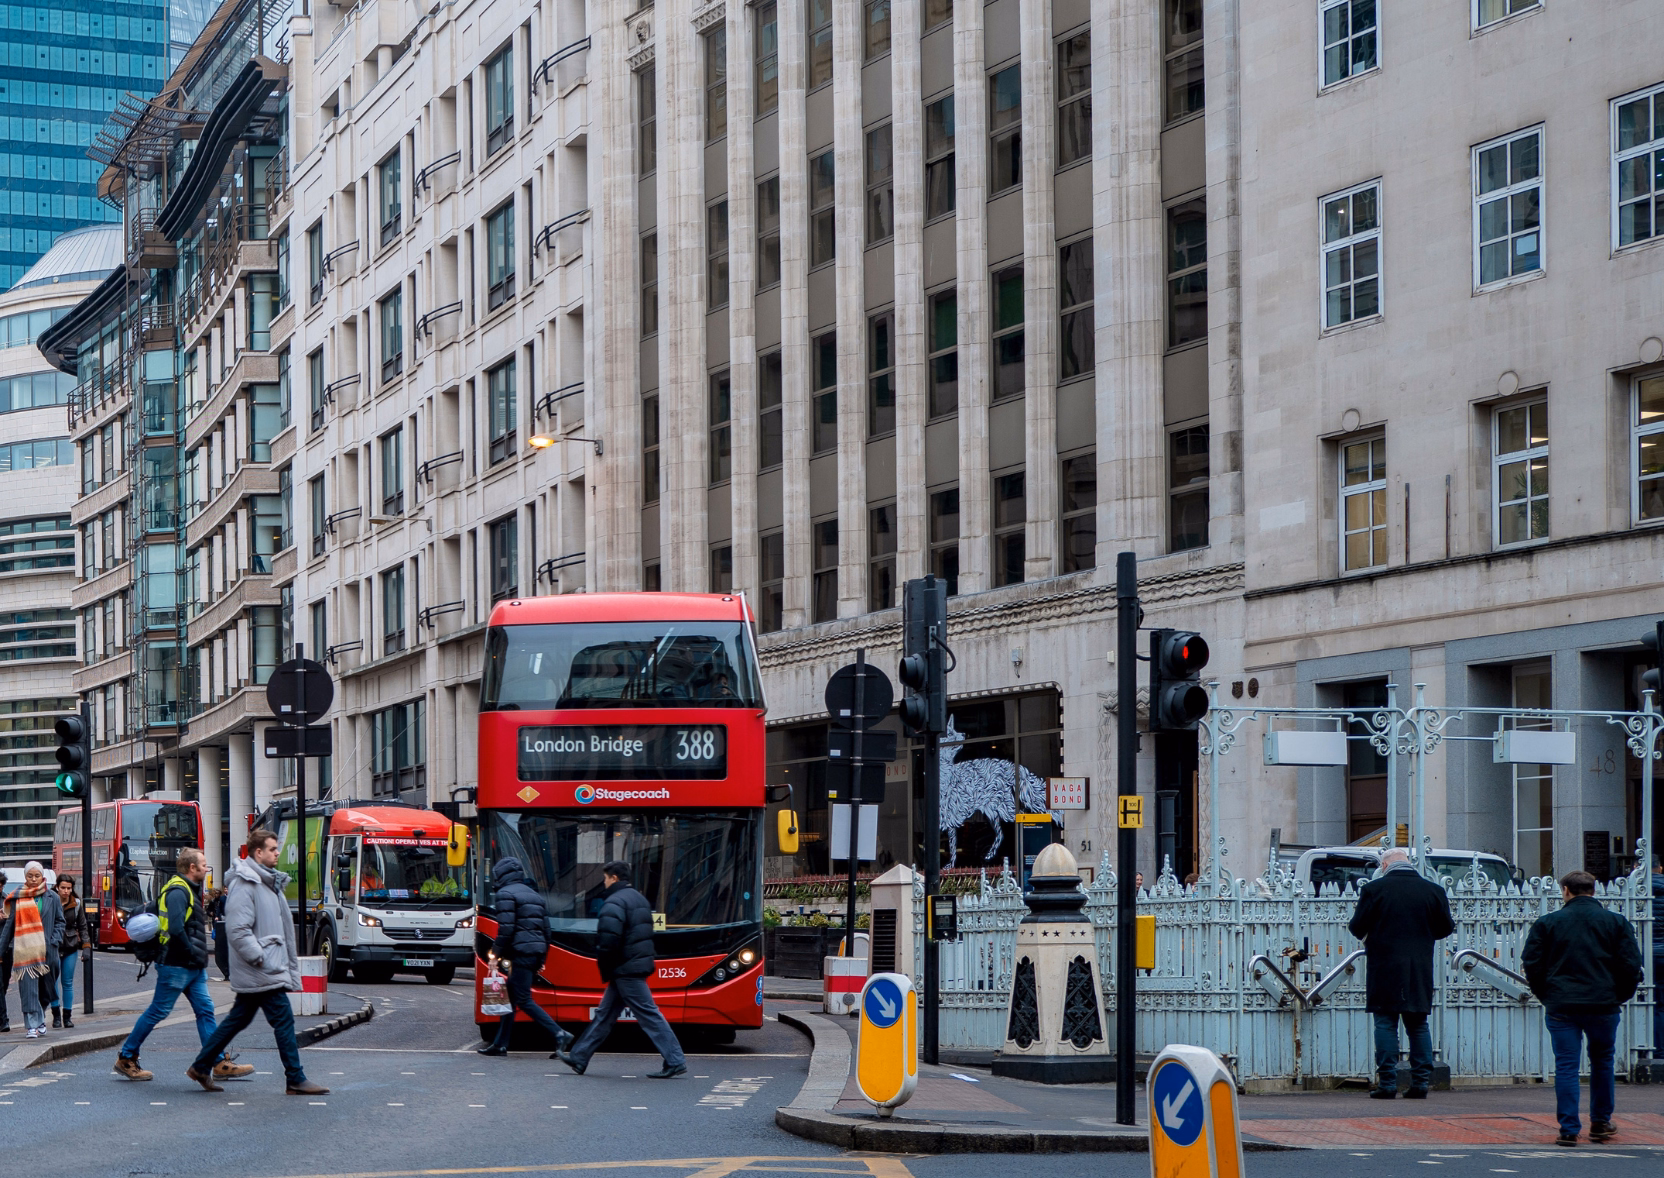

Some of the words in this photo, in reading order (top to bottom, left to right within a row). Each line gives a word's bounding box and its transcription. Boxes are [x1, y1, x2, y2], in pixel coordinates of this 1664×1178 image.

[525, 736, 585, 753] London
[590, 735, 643, 757] Bridge
[676, 730, 715, 760] 388
[1053, 784, 1082, 792] VAGA
[595, 787, 670, 802] Stagecoach
[1053, 795, 1082, 804] BOND
[129, 848, 149, 856] Clapham
[149, 848, 168, 856] Junction
[1080, 840, 1092, 852] 51
[658, 967, 687, 979] 12536
